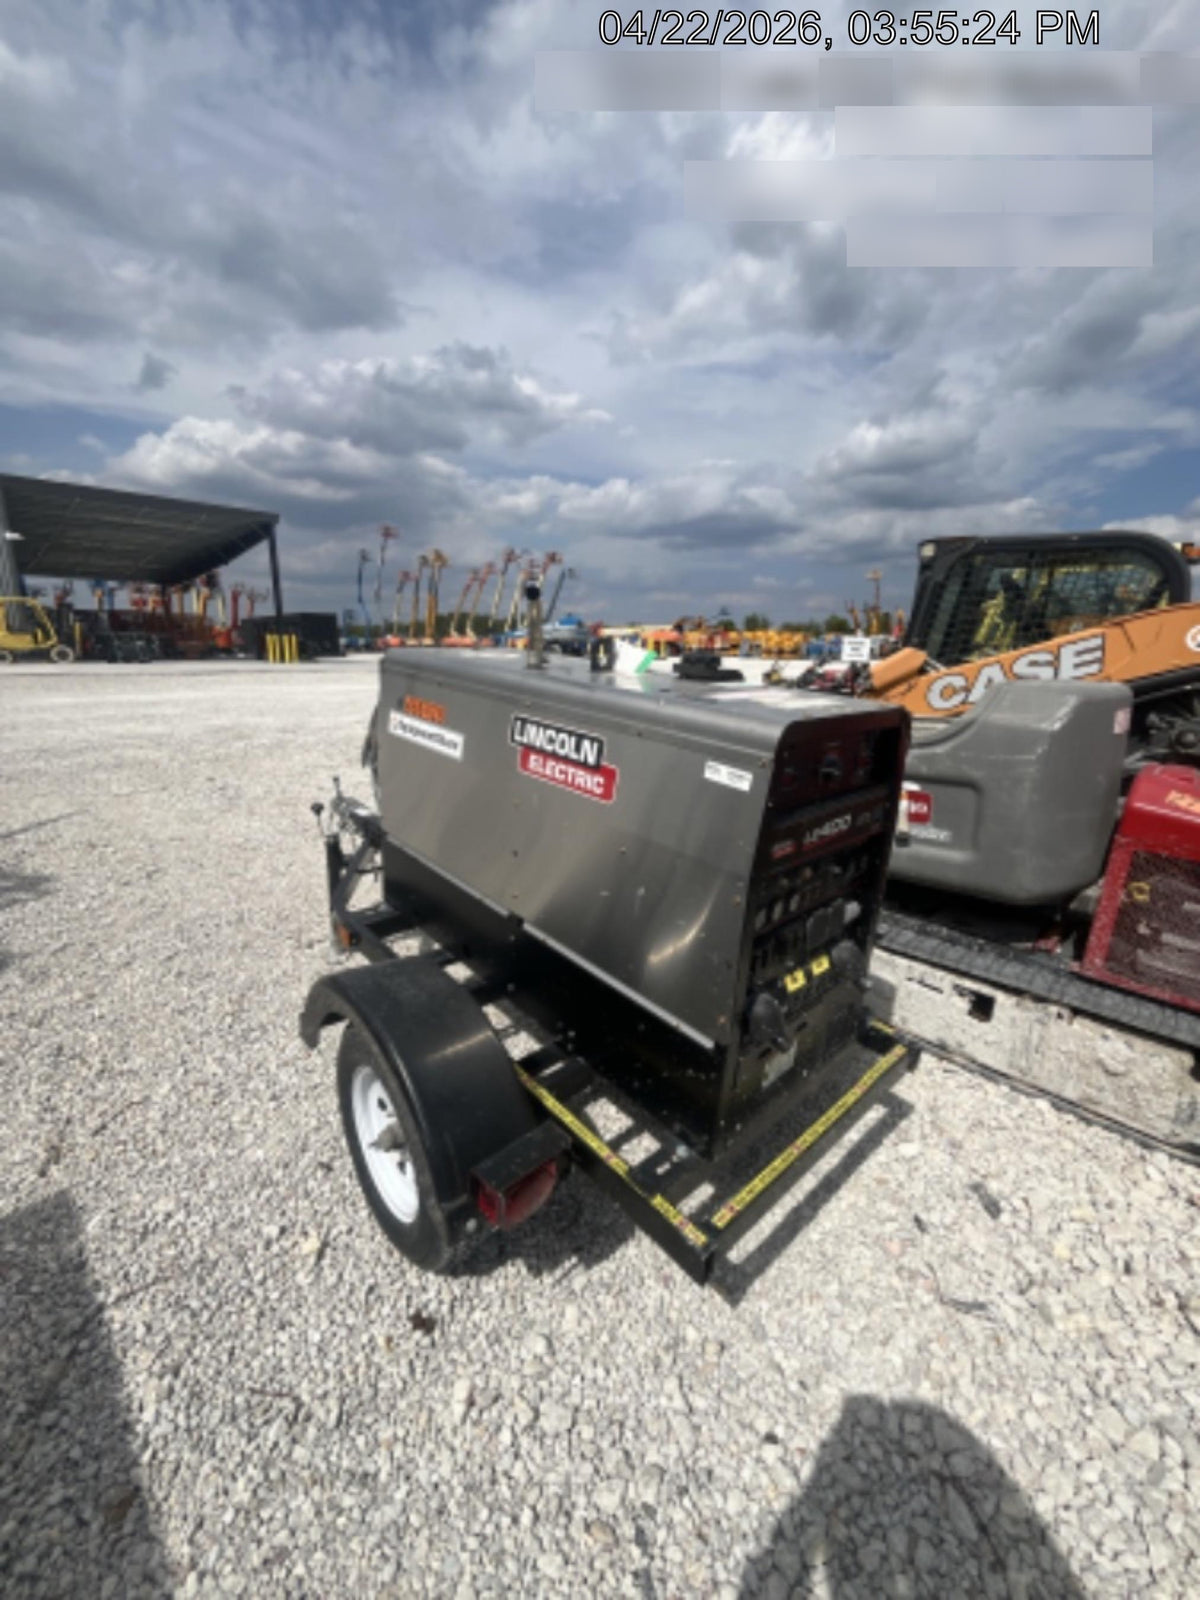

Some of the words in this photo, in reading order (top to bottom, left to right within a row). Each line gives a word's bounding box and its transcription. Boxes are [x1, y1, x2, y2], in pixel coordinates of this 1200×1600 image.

[925, 633, 1104, 711] CASE
[512, 718, 600, 767] LINCOLN
[527, 753, 606, 796] ELECTRIC
